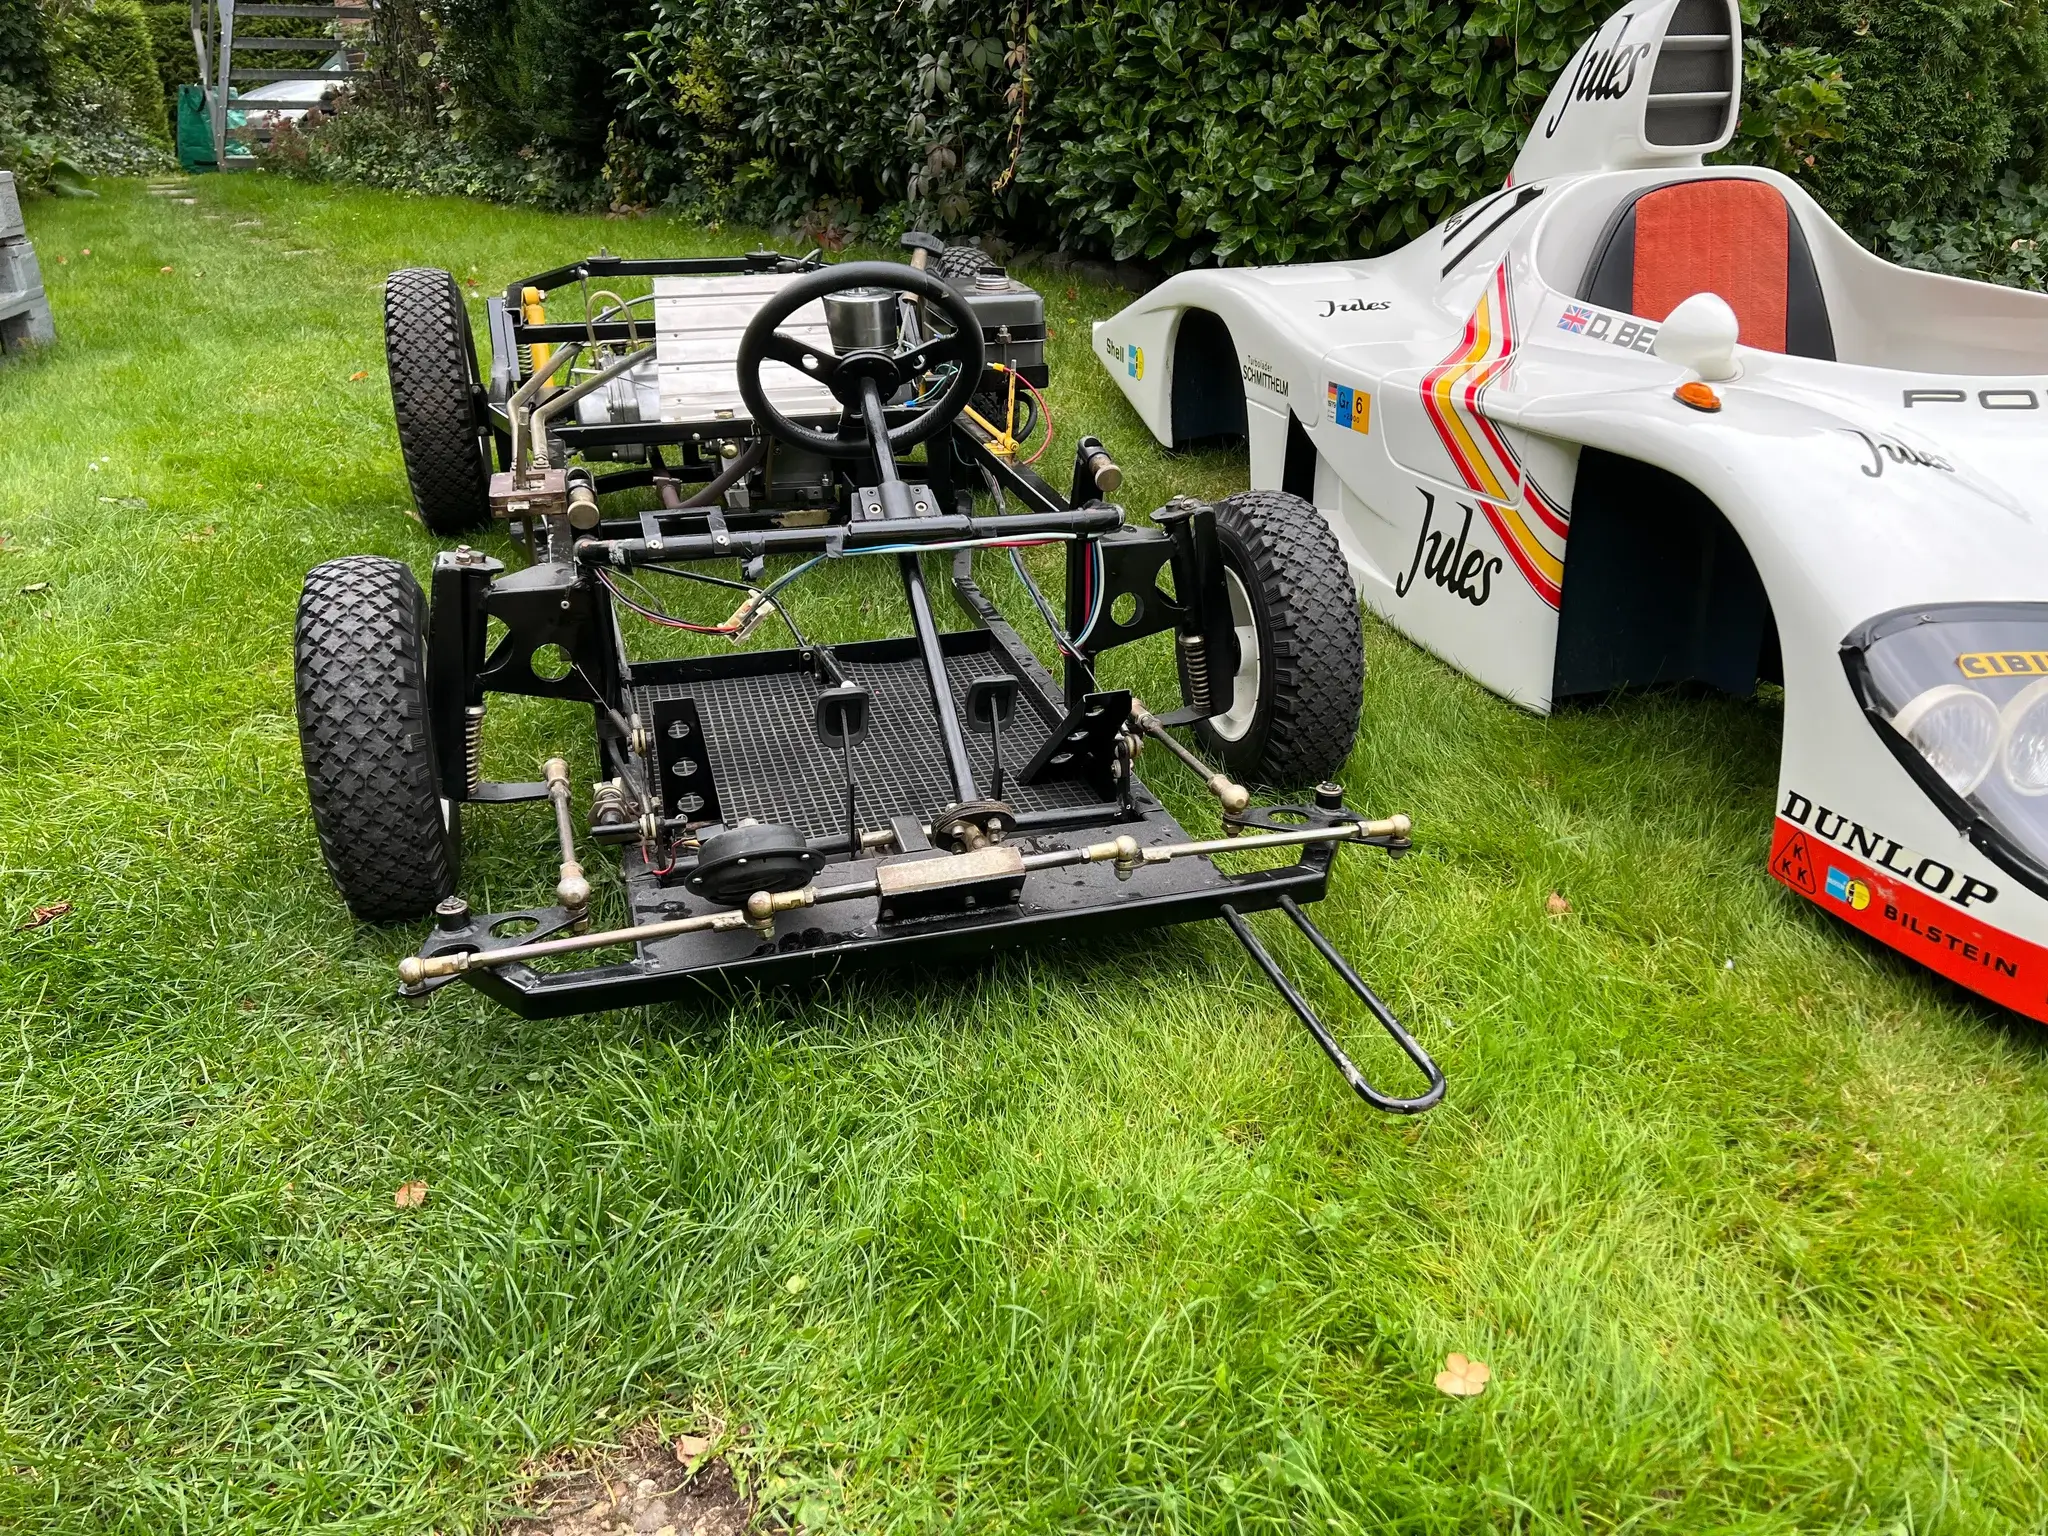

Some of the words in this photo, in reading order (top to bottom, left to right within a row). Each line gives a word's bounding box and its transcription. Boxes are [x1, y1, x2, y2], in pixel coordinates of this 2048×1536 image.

[1546, 13, 1651, 139] Jules
[1315, 298, 1392, 318] Jules
[1586, 312, 1612, 341] D.
[1106, 337, 1125, 363] Shell
[1242, 364, 1289, 397] SCHMITTHELM
[1338, 391, 1350, 410] Gr
[1356, 396, 1363, 414] 6
[1903, 389, 2048, 410] PO
[1395, 485, 1503, 606] Jules
[1962, 654, 2048, 675] CIBI
[1781, 789, 1999, 908] DUNLOP
[1793, 843, 1804, 861] K
[1781, 858, 1792, 875] K
[1797, 866, 1808, 884] K
[1884, 904, 2019, 978] BILSTEIN
